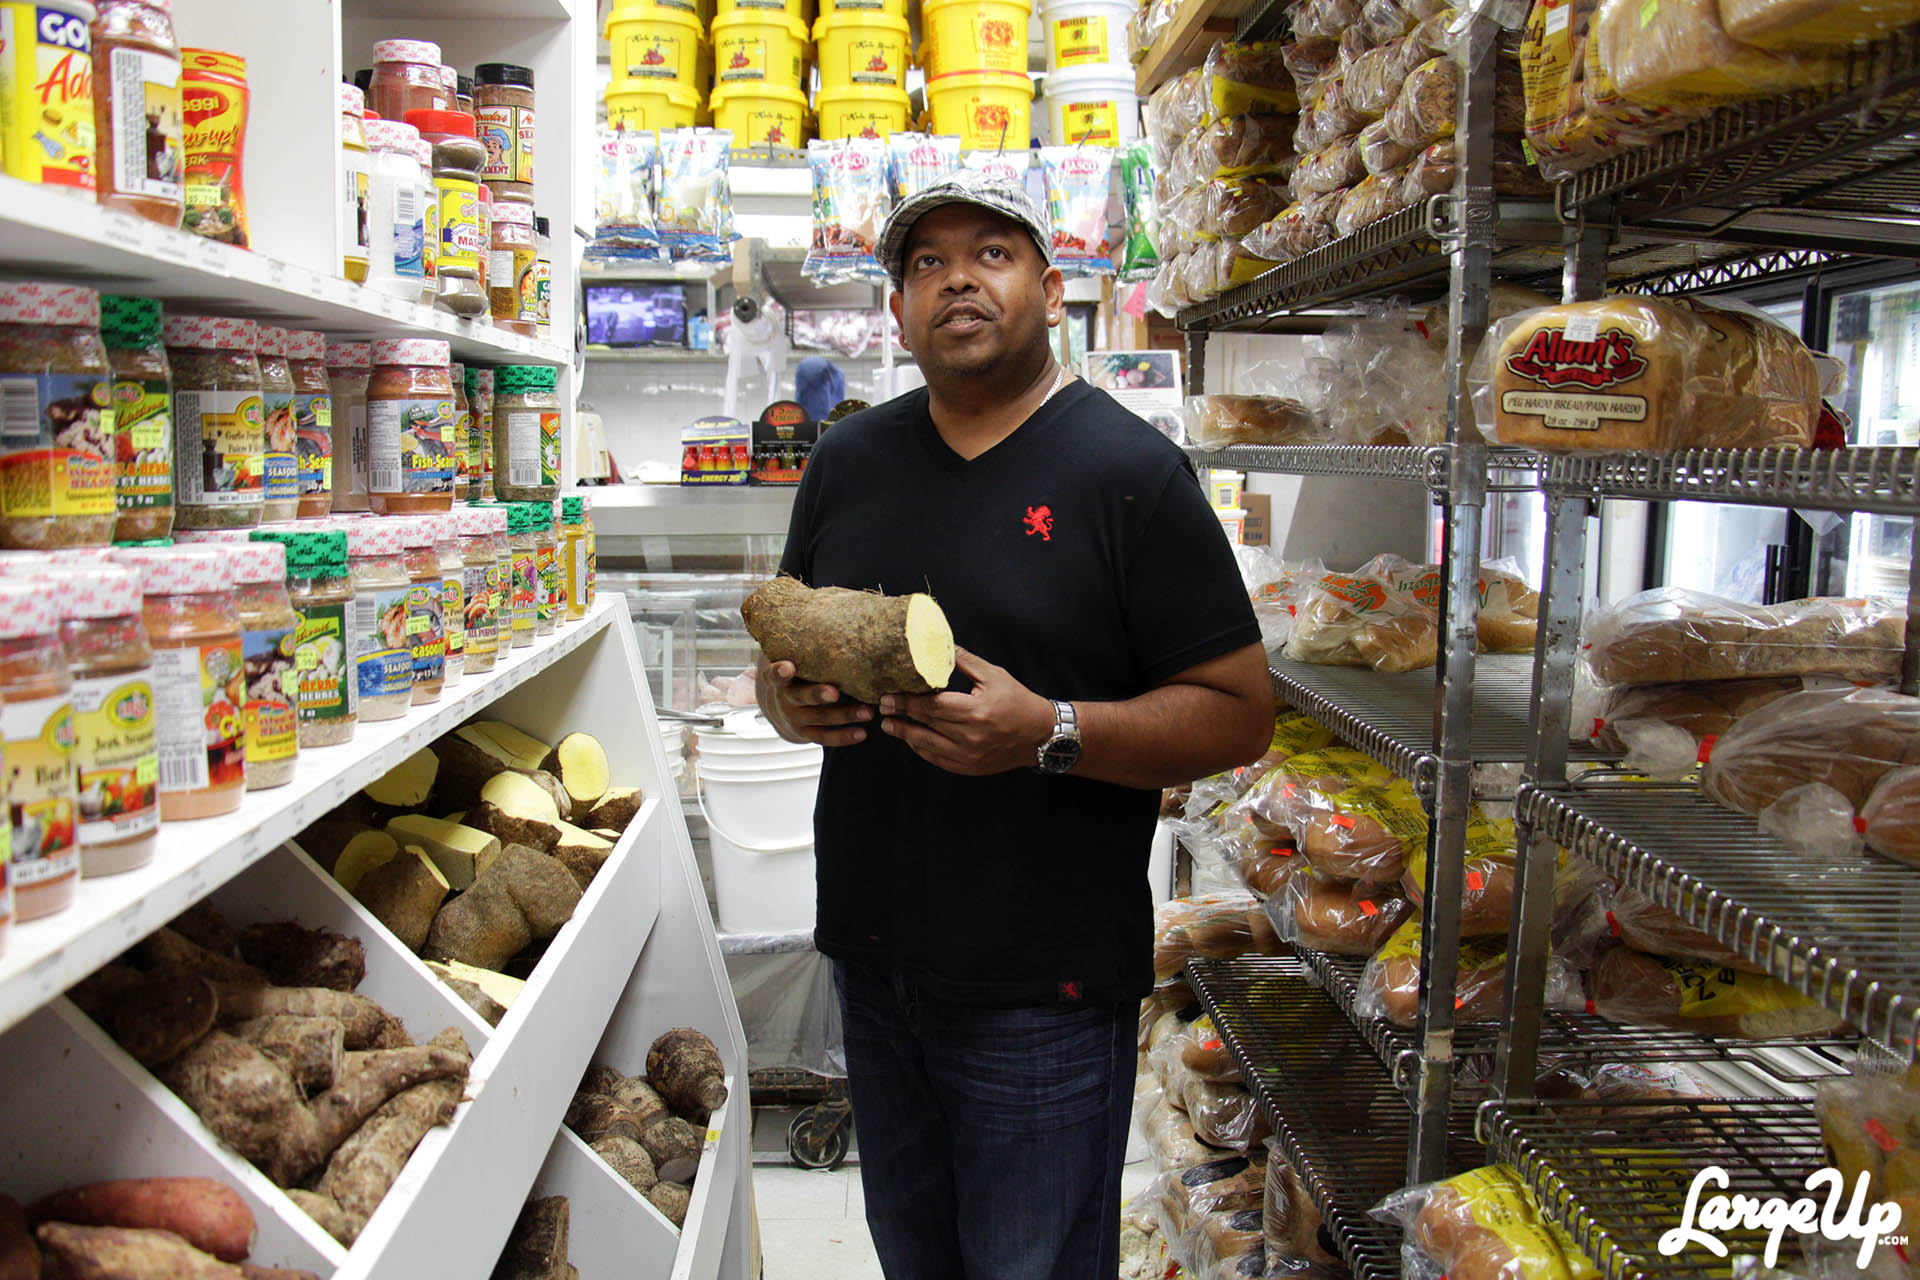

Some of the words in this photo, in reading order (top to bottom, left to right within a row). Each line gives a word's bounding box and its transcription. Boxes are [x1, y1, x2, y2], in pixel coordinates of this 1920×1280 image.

[40, 13, 90, 46] GO
[1063, 158, 1098, 171] LASCO
[1524, 328, 1633, 366] Allan's
[1507, 397, 1523, 408] PEG
[1524, 398, 1551, 410] HARDO
[1609, 403, 1642, 415] HARDO
[301, 677, 338, 693] HERBS
